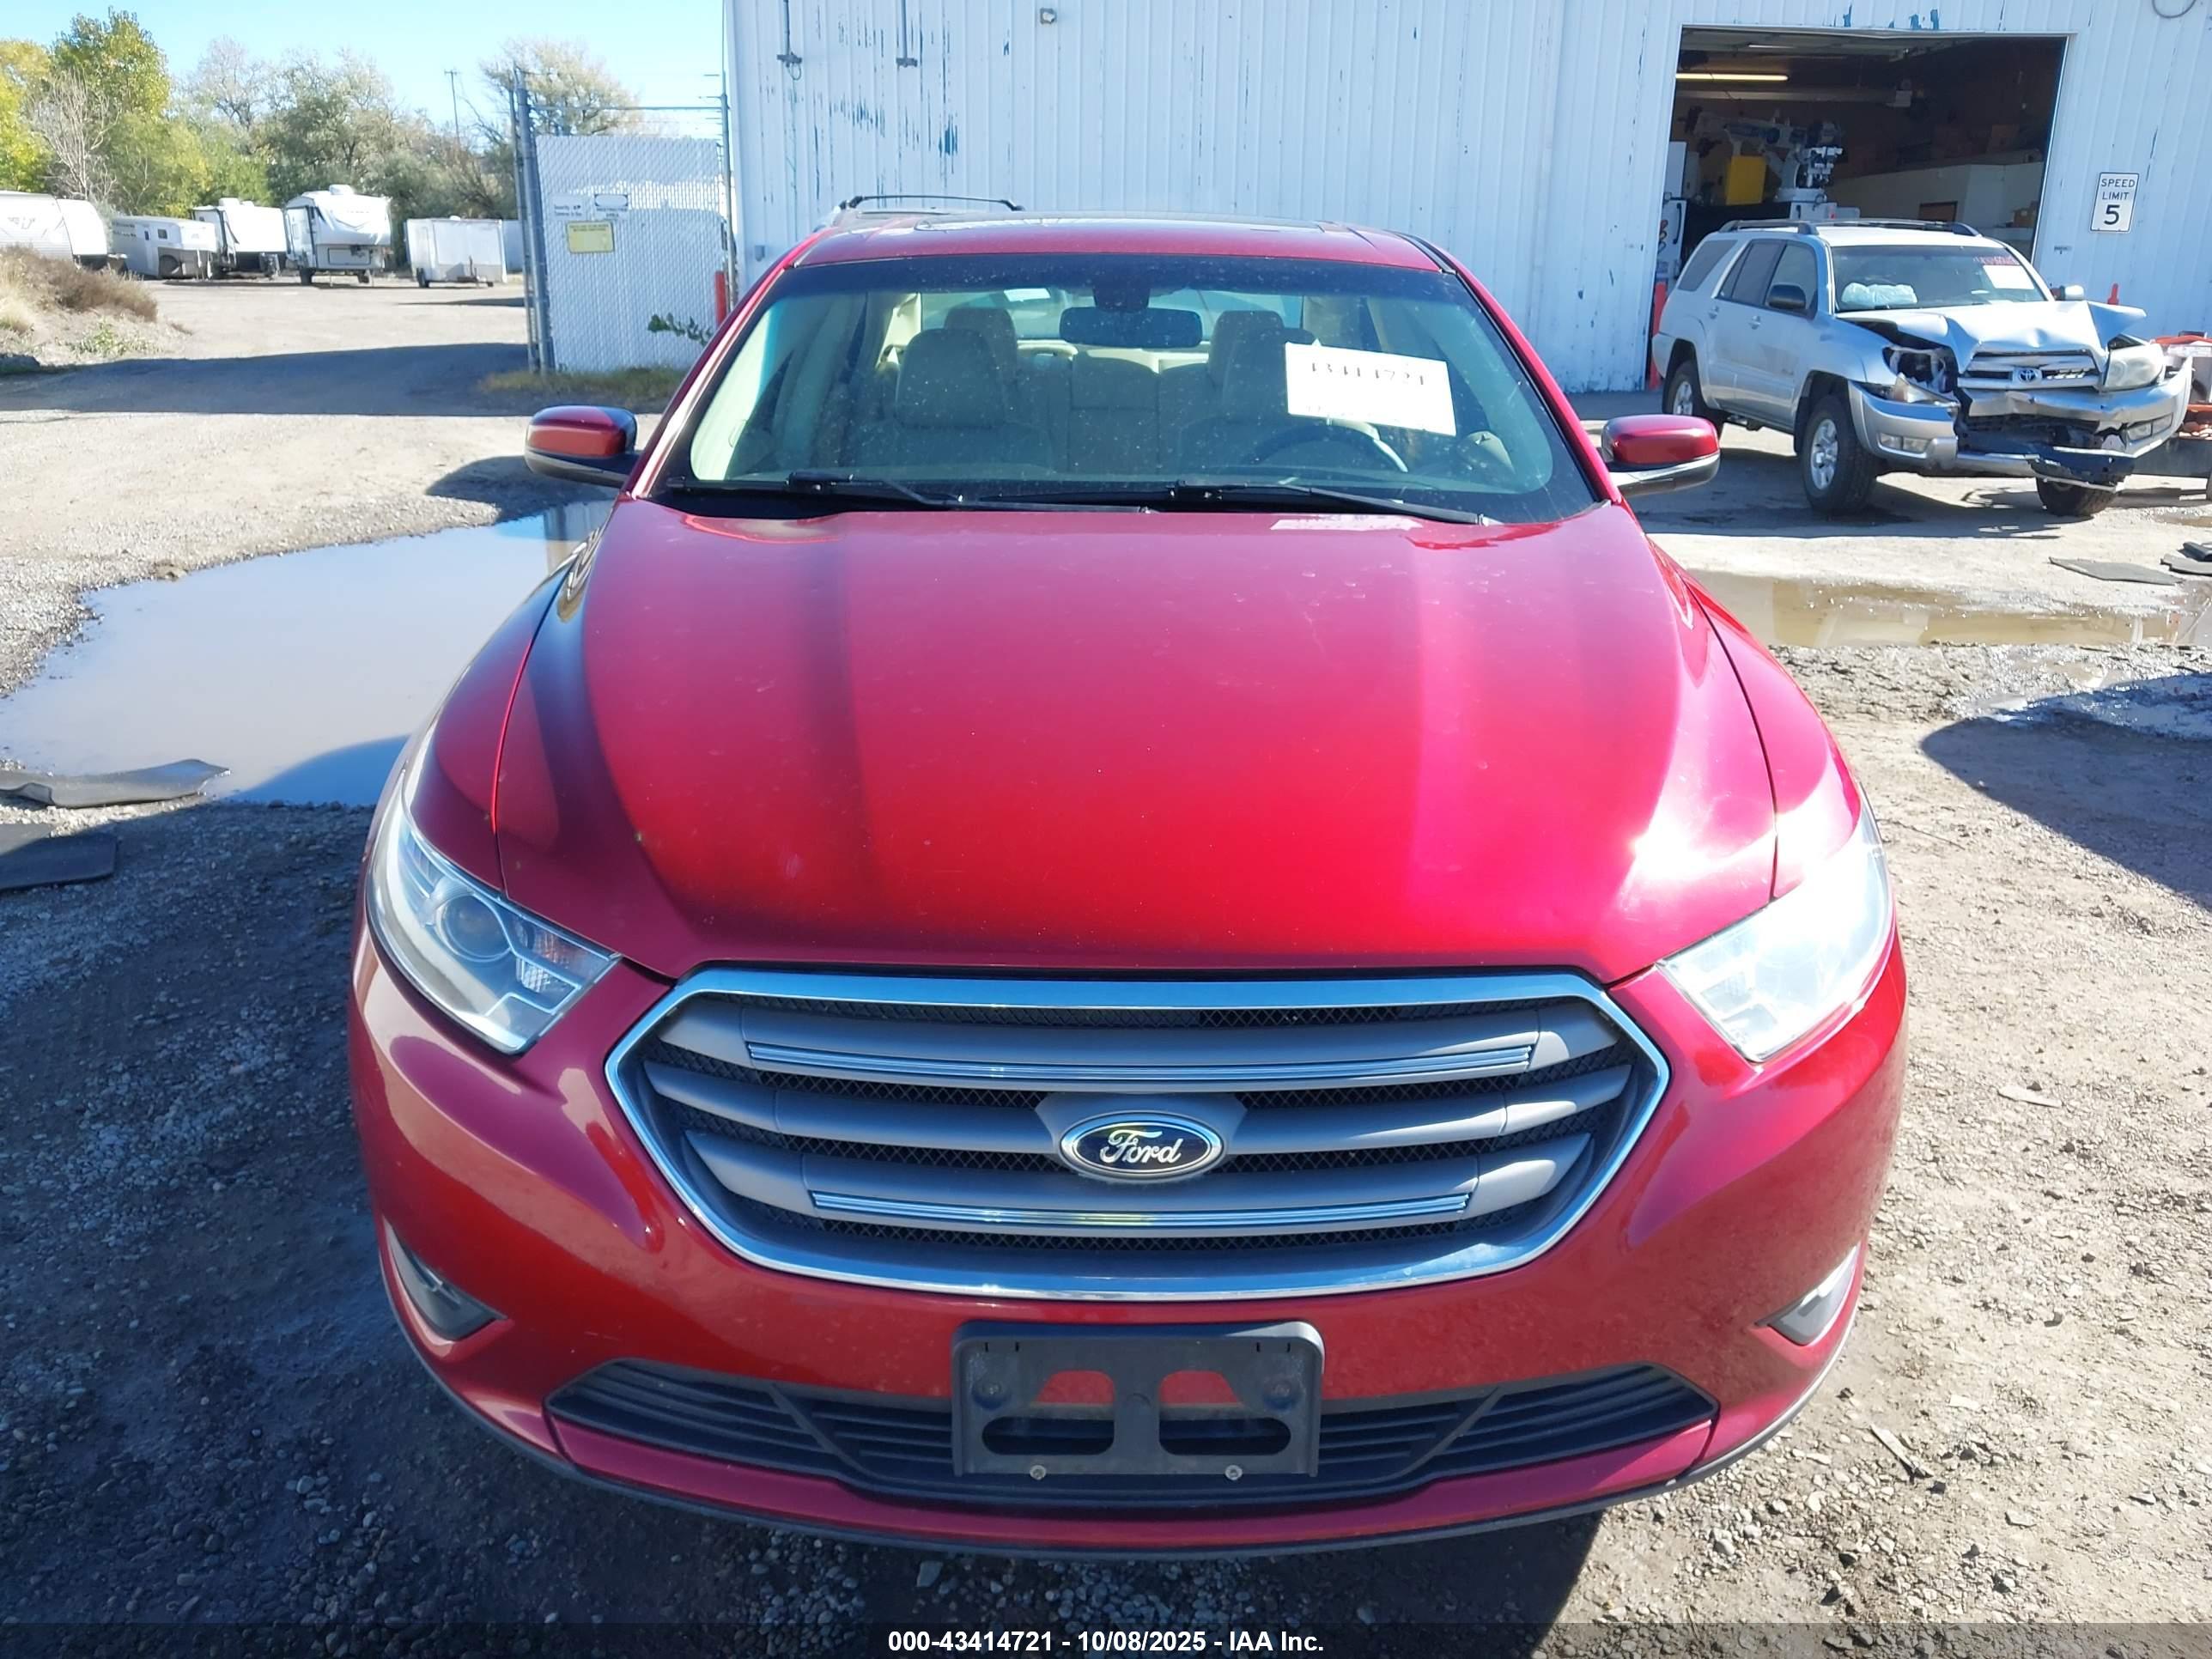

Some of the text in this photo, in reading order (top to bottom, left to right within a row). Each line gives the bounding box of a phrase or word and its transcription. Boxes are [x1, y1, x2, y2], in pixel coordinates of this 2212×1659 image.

[2101, 179, 2136, 187] SPEED
[2102, 191, 2130, 200] LIMIT
[2104, 204, 2120, 225] 5
[1100, 1129, 1183, 1164] Ford
